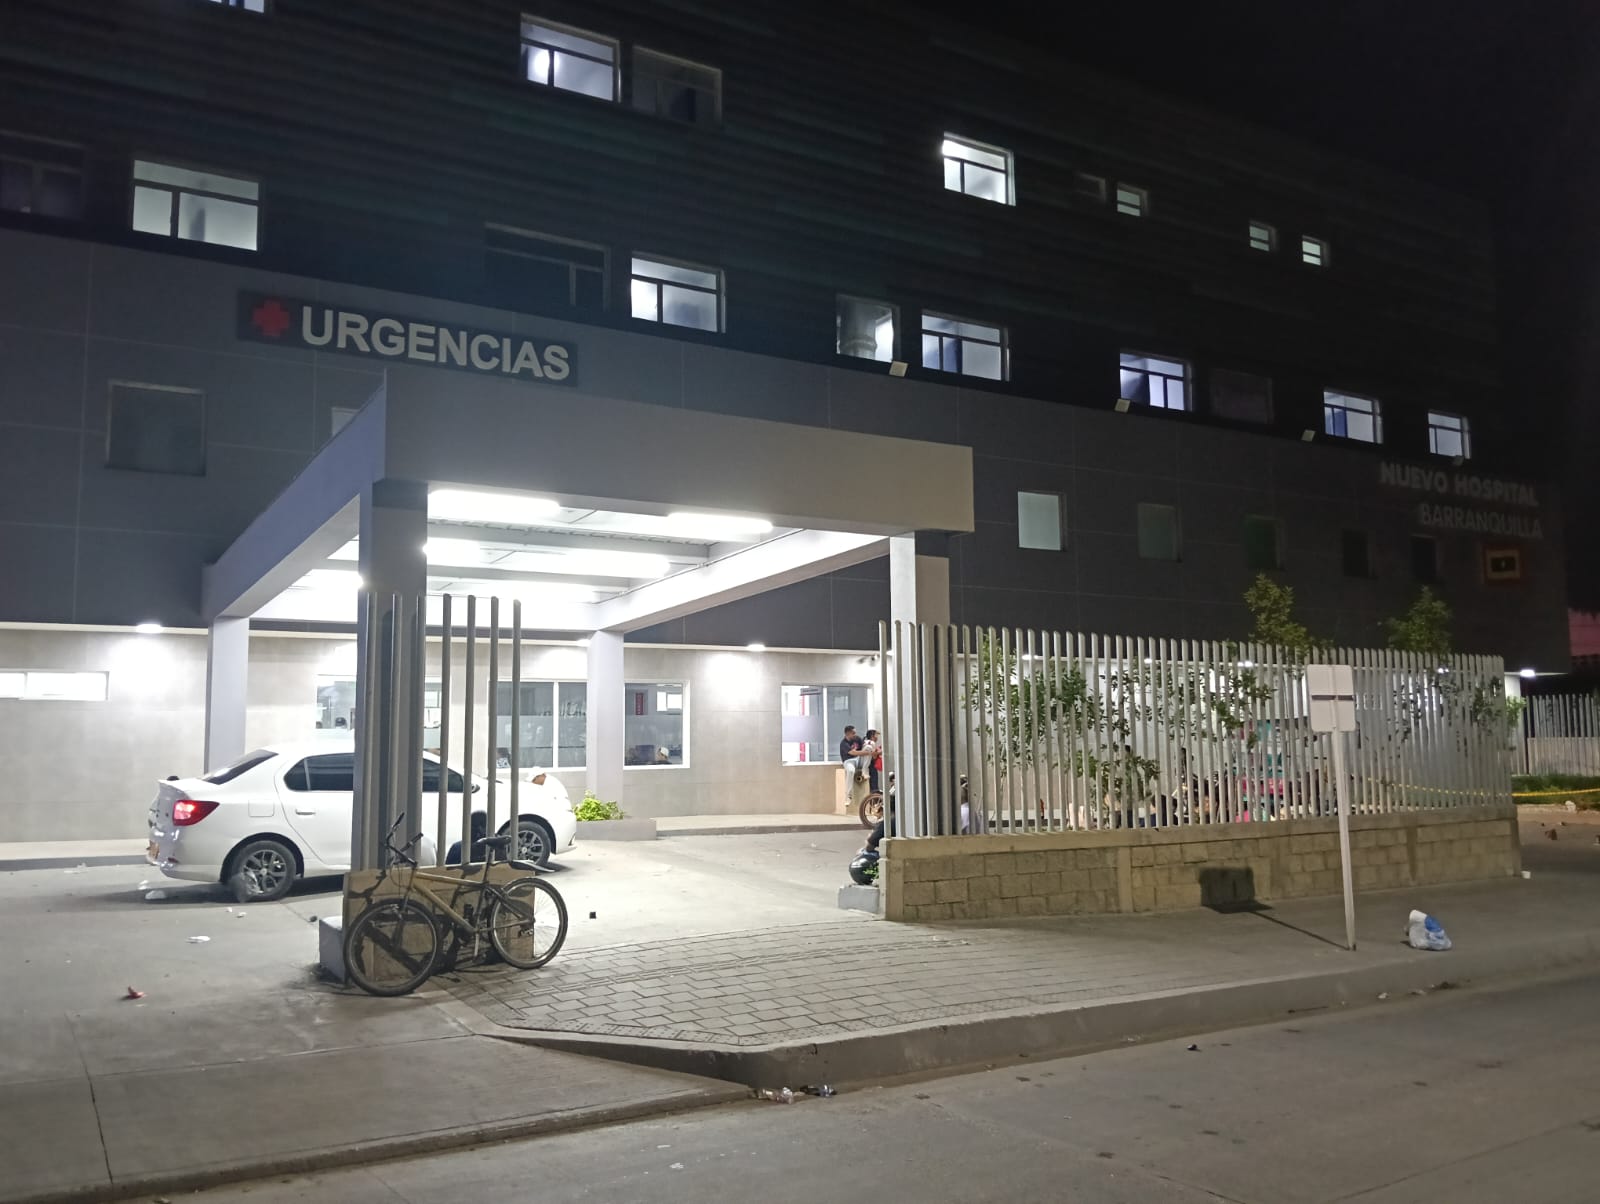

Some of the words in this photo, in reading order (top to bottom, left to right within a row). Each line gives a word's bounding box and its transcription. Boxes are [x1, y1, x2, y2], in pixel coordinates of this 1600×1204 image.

[301, 305, 570, 381] URGENCIAS
[1380, 462, 1448, 494] NUEVO
[1454, 474, 1539, 507] HOSPITAL
[1420, 503, 1544, 539] BARRANQUILLA
